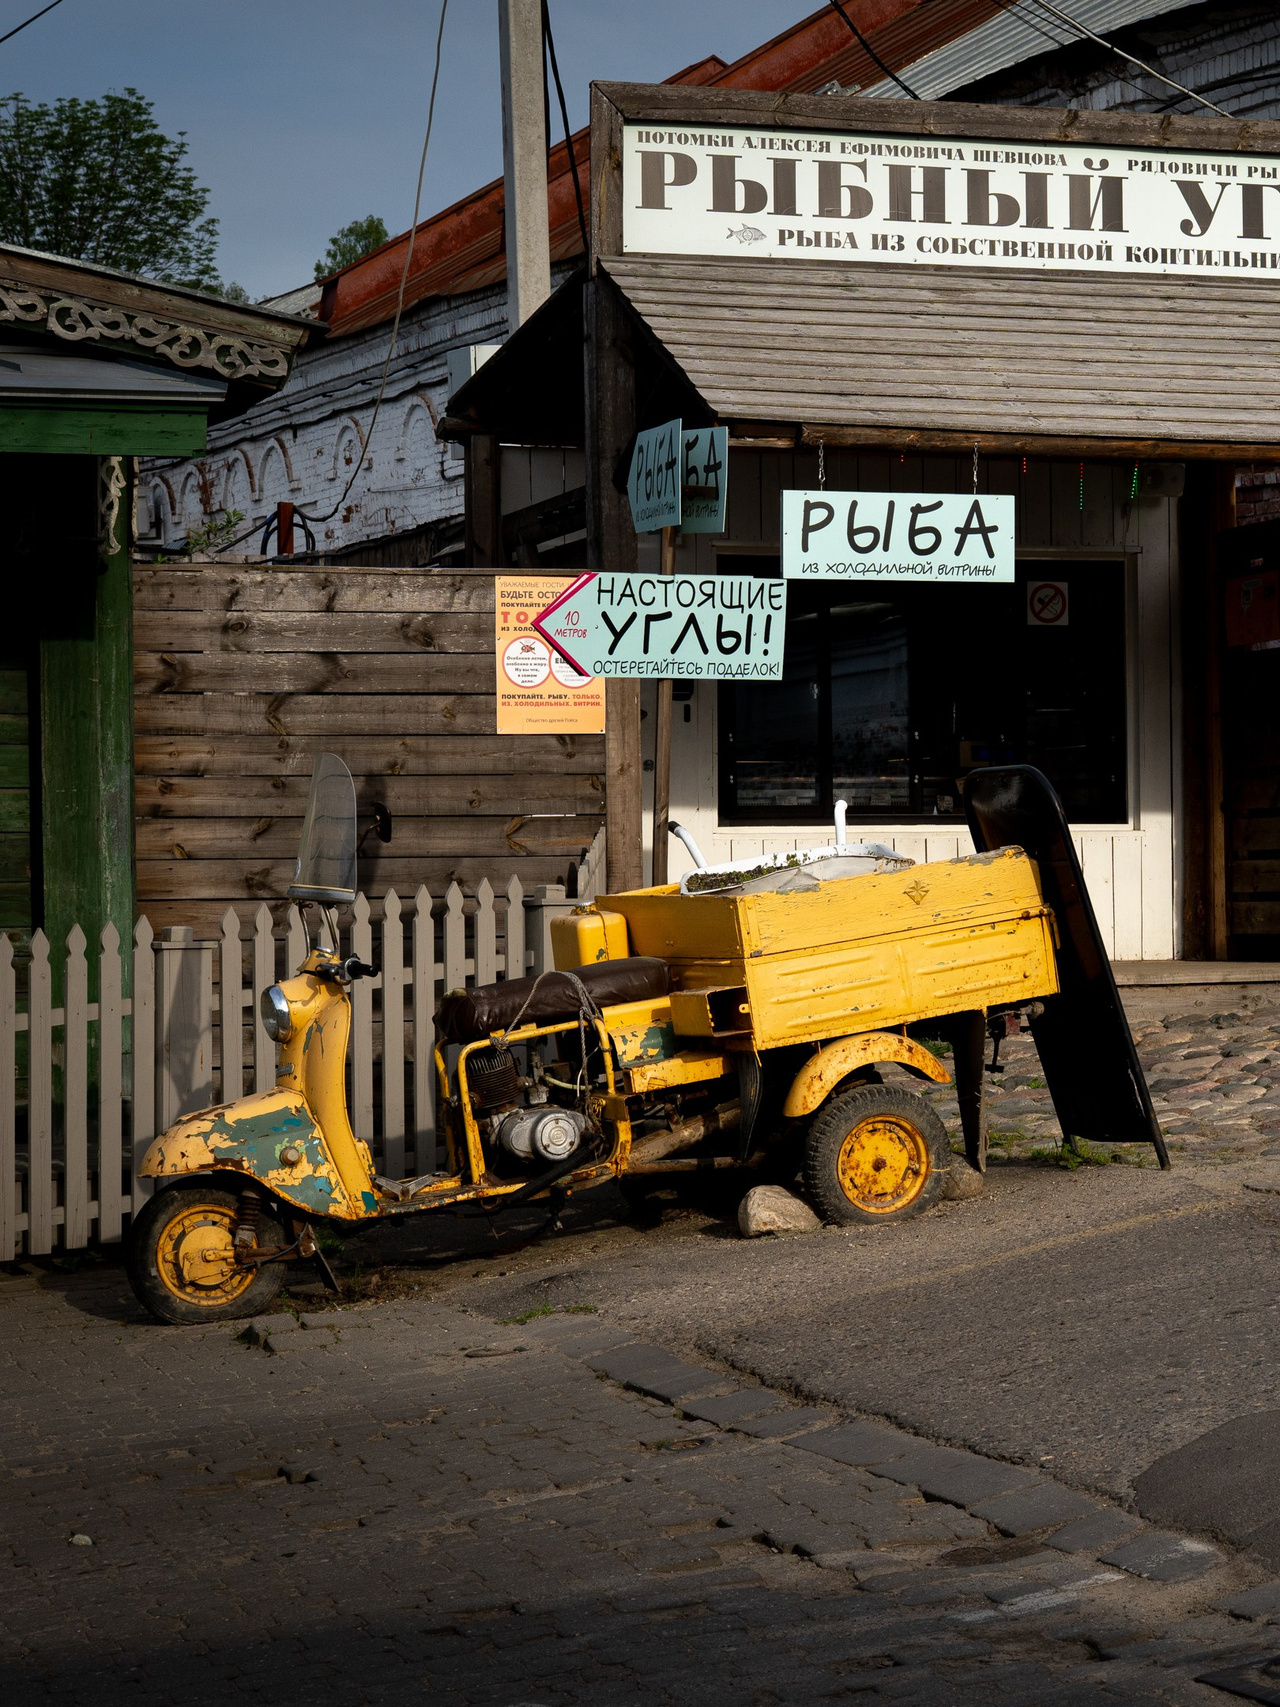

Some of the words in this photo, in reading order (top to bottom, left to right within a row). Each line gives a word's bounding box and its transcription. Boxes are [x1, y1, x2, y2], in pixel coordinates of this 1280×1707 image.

[636, 130, 735, 148] ПОТОМКИ
[742, 136, 832, 153] АЛЕКСЕЯ
[840, 142, 965, 161] ЕФИМОВИЧА
[973, 149, 1068, 167] ШЕВЦОВА
[1128, 159, 1239, 177] РЯДОВИЧИ
[635, 150, 1130, 233] РЫБНЫЙ
[777, 229, 859, 249] РЫБА
[870, 233, 905, 251] ИЗ
[916, 235, 1114, 261] СОБСТВЕННОЙ
[636, 427, 677, 504] РЫБА
[801, 499, 999, 559] РЫБА
[801, 562, 819, 574] ИЗ
[825, 561, 933, 577] ХОЛОДИЛЬНОЙ
[938, 564, 997, 577] ВИТРИНЫ
[501, 591, 533, 599] БУДЬТЕ
[597, 576, 785, 613] НАСТОЯЩИЕ
[554, 629, 587, 638] МЕТРОВ
[565, 611, 579, 625] 10
[601, 611, 773, 656] УГЛЫ!
[593, 657, 703, 676] ОСТЕРЕГАЙТЕСЬ
[706, 662, 780, 678] ПОДДЕЛОК!
